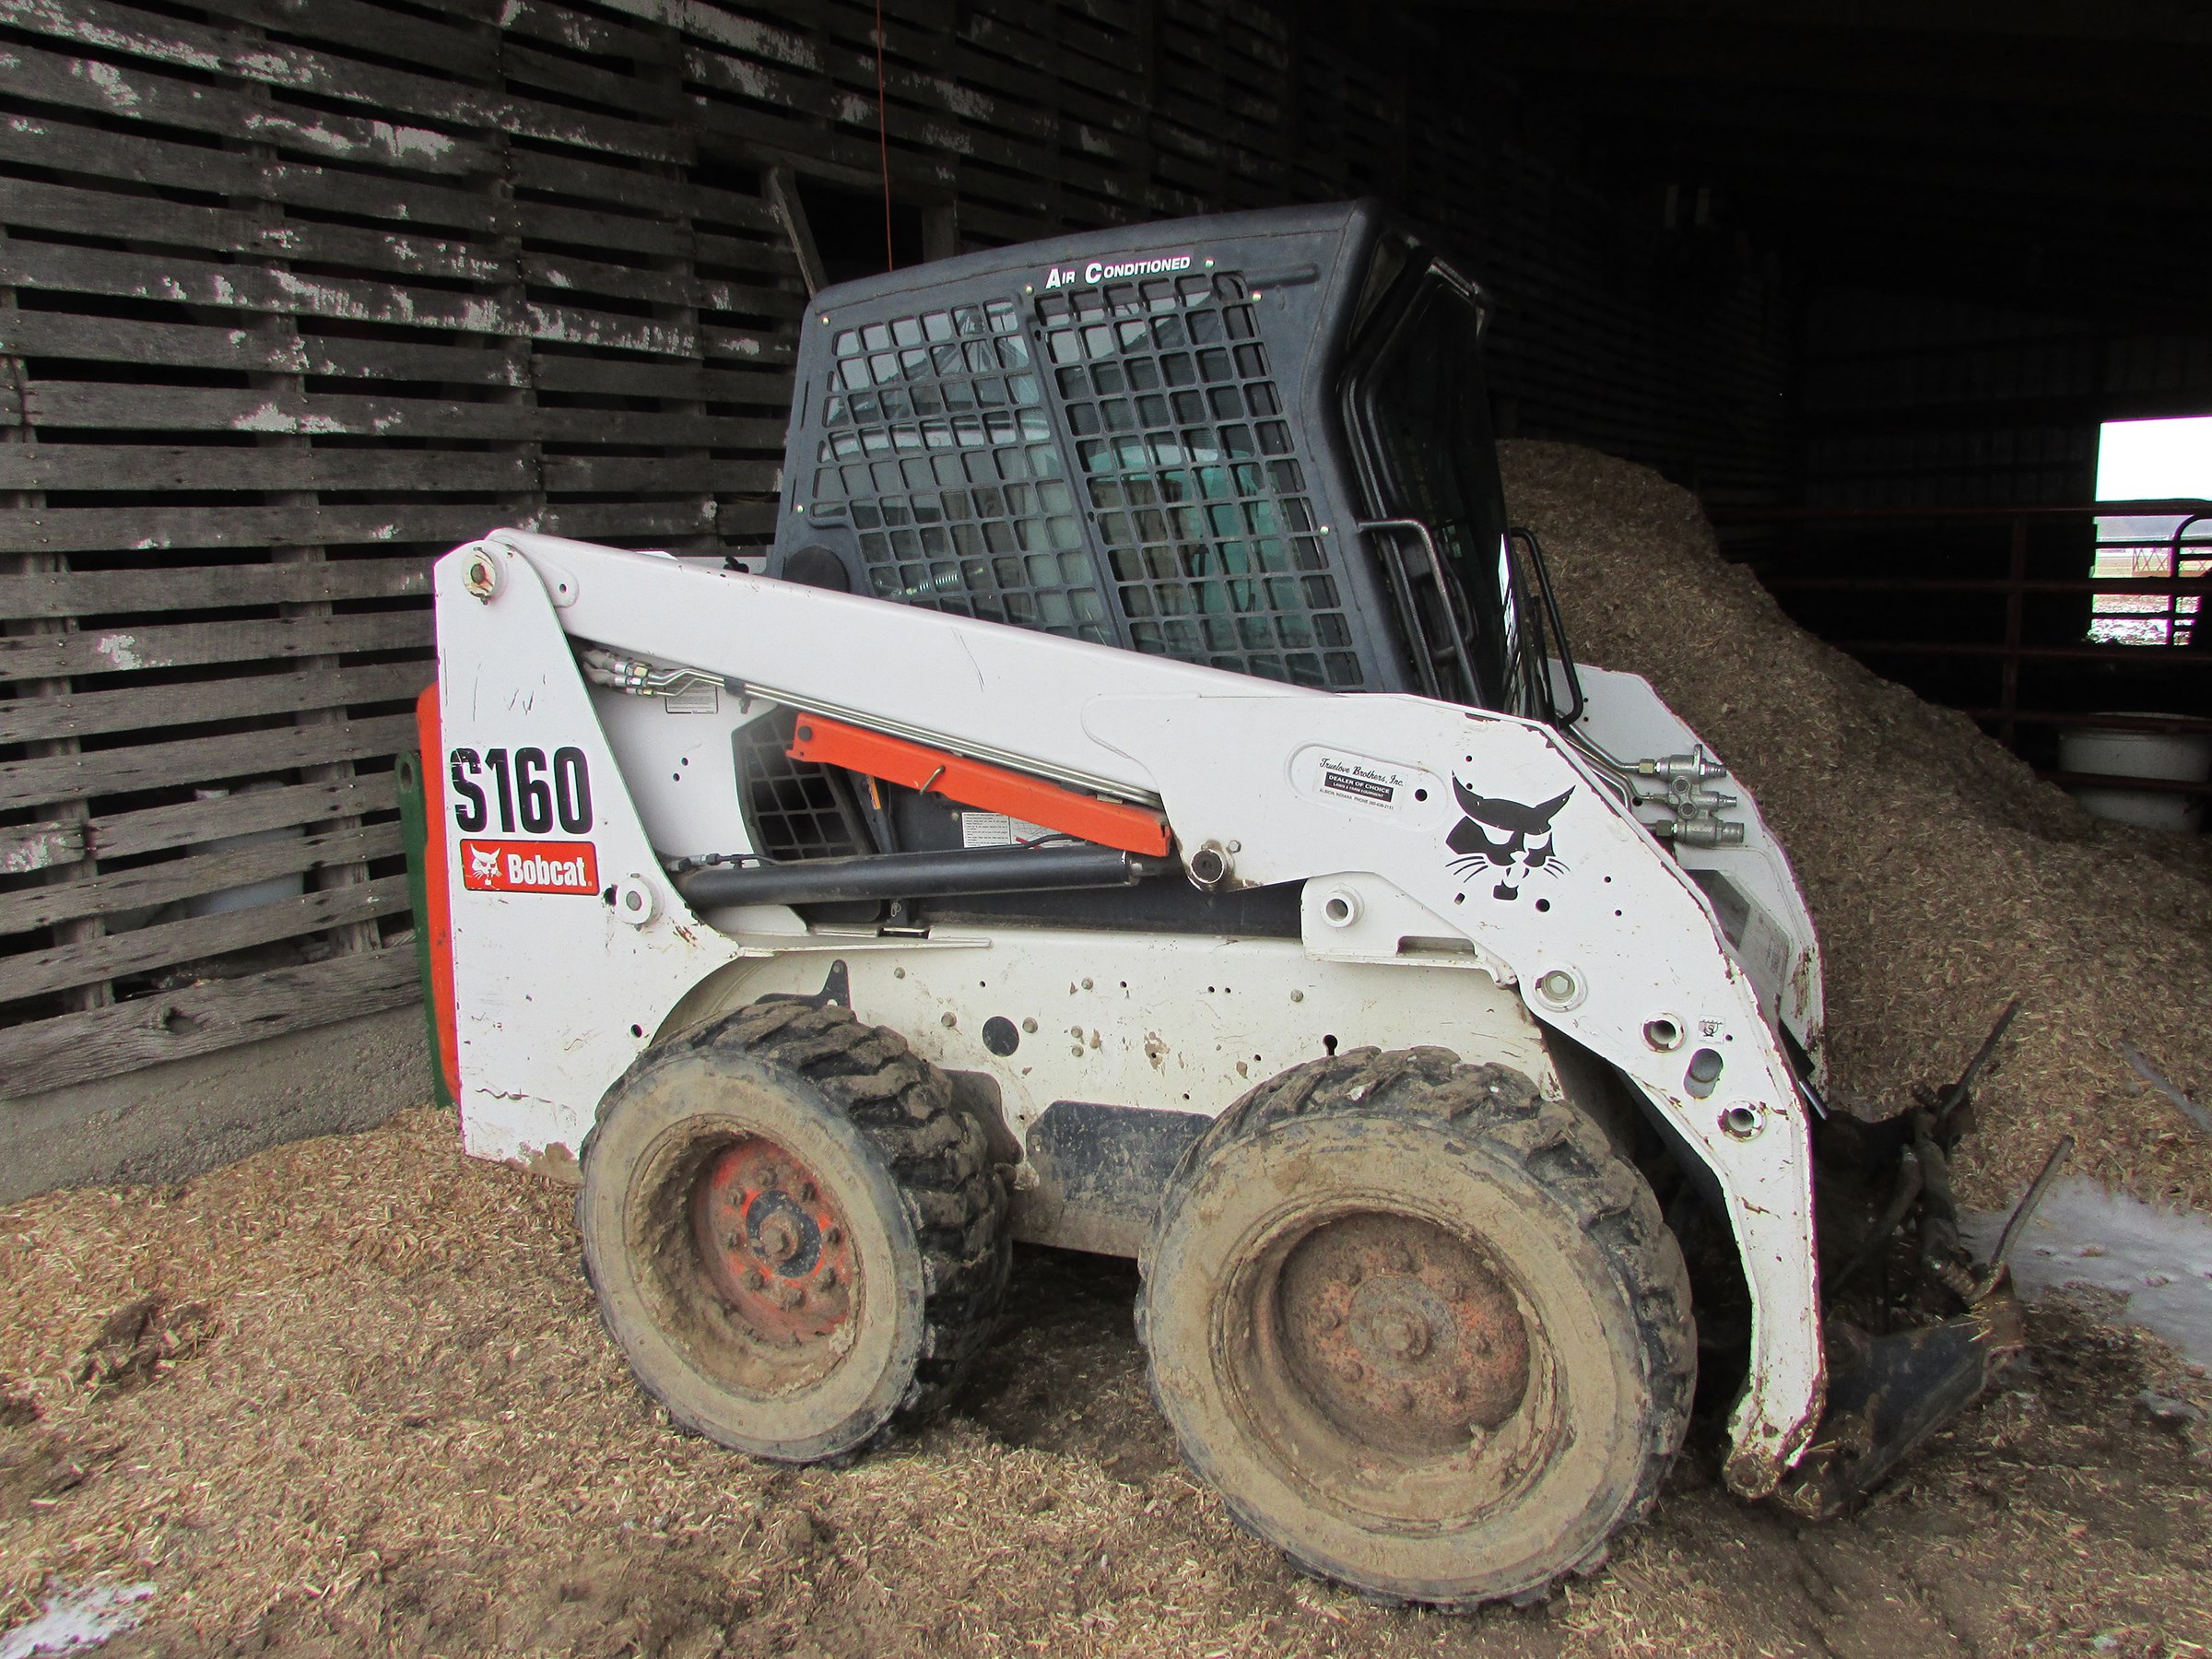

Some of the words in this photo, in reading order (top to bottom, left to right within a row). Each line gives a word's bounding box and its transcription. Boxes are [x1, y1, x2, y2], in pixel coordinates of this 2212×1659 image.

[1319, 758, 1350, 773] Truelove
[1352, 766, 1387, 783] Brothers,
[1389, 774, 1405, 787] Inc.
[1328, 775, 1354, 785] DEALER
[1364, 784, 1390, 794] CHOICE
[450, 747, 594, 834] S160
[507, 853, 587, 887] Bobcat
